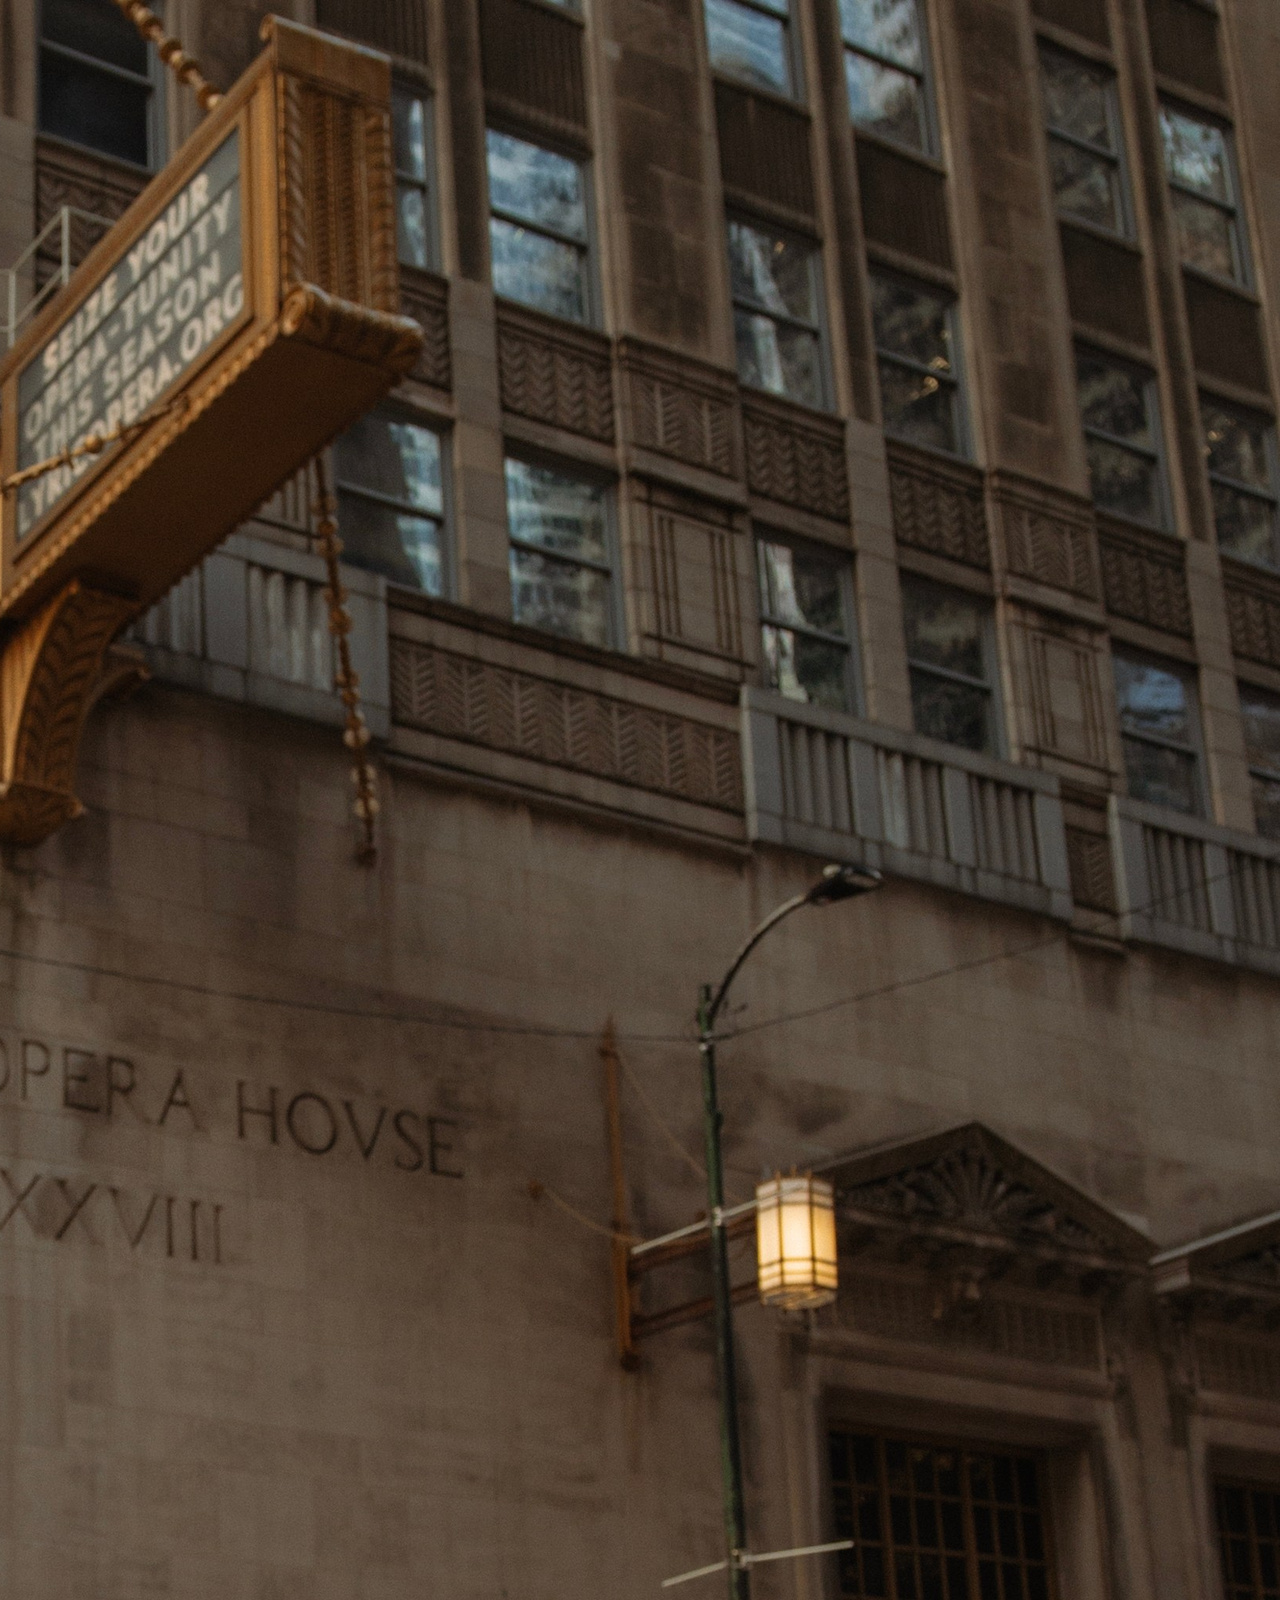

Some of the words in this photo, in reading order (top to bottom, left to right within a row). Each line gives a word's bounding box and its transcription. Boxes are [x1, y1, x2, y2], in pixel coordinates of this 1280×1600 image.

[24, 189, 232, 441] OPERA-TUNITY
[35, 383, 94, 464] THIS
[104, 250, 220, 398] SEASON
[42, 272, 119, 382] SEIZE
[128, 172, 210, 281] YOUR
[236, 1079, 465, 1179] HOVSE
